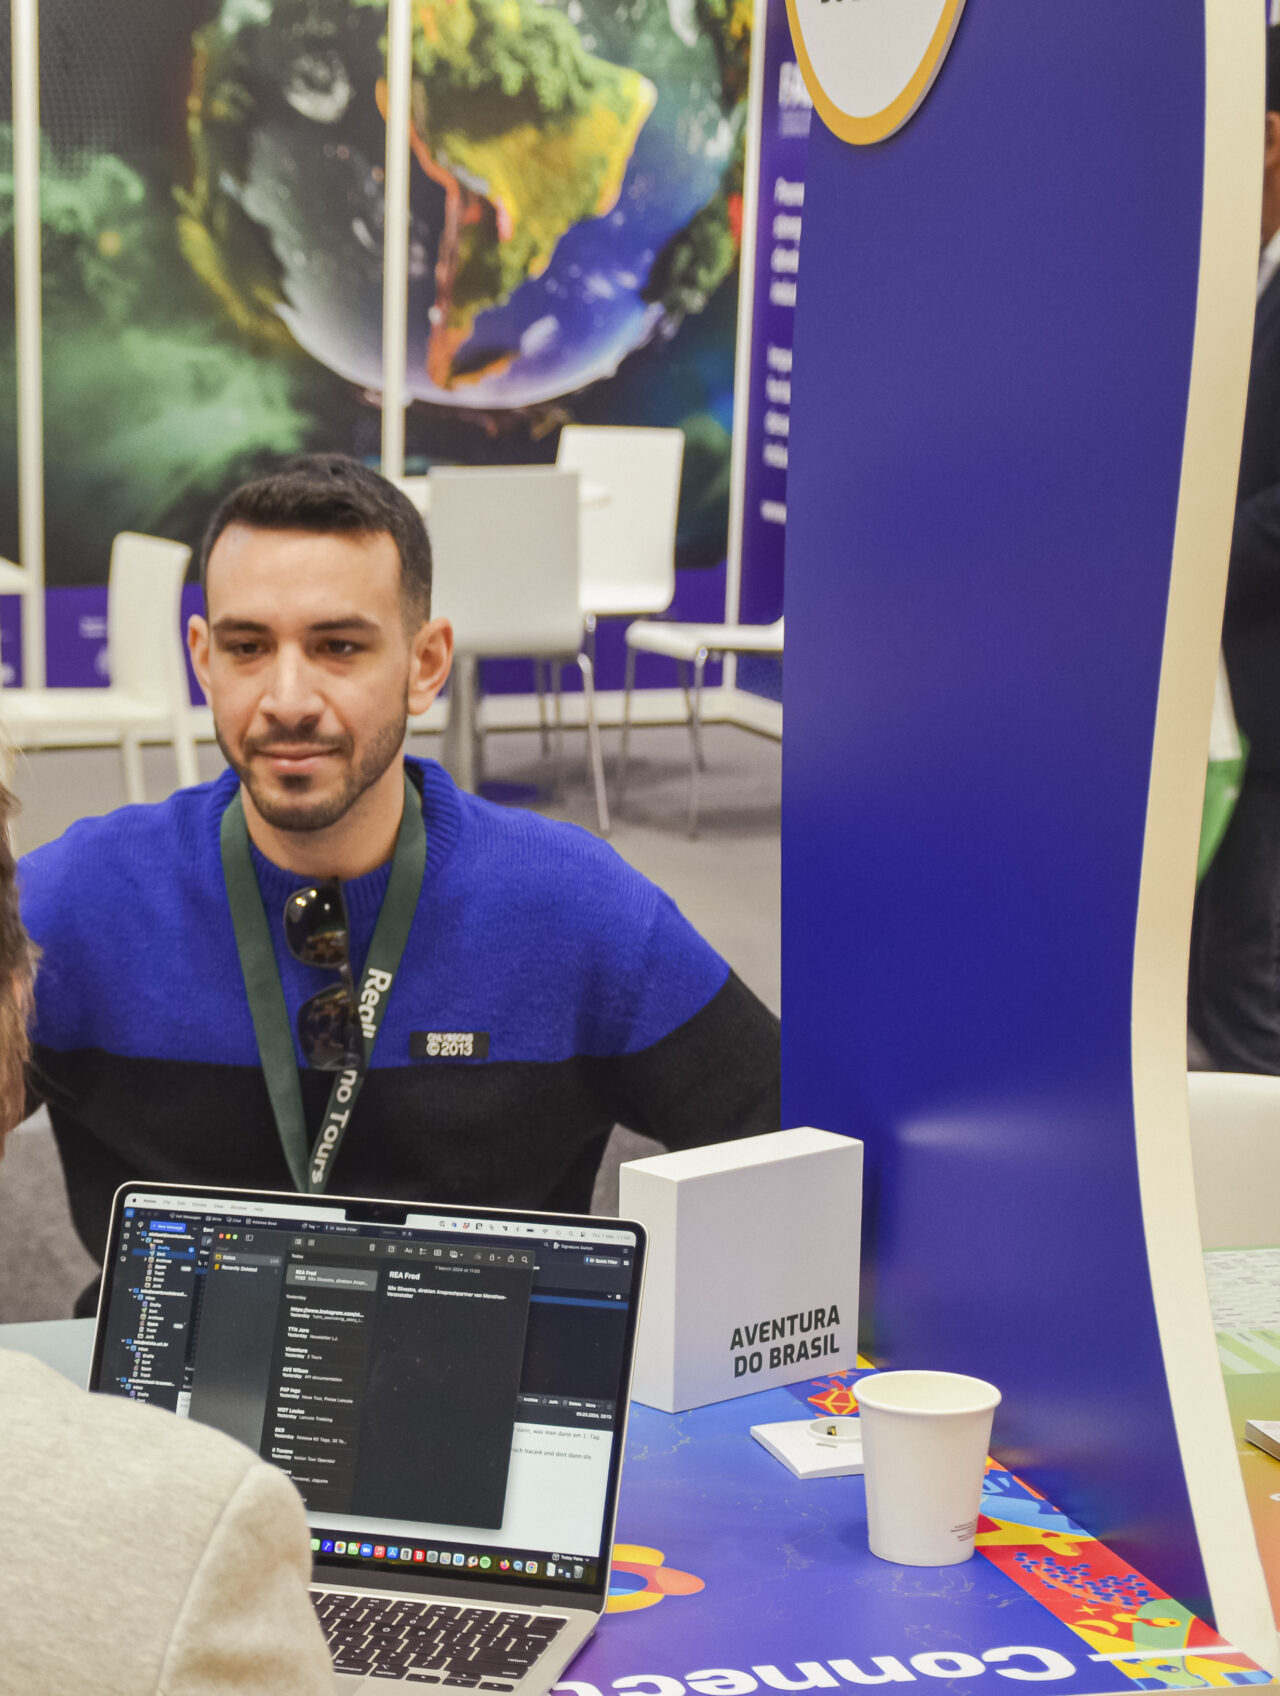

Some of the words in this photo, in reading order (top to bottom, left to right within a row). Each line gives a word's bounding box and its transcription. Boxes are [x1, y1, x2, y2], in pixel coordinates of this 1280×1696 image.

[311, 1109, 349, 1184] Tours
[389, 1271, 404, 1280] REA
[404, 1272, 421, 1281] Fred
[730, 1305, 840, 1350] AVENTURA
[734, 1351, 762, 1377] DO
[769, 1333, 840, 1369] BRASIL
